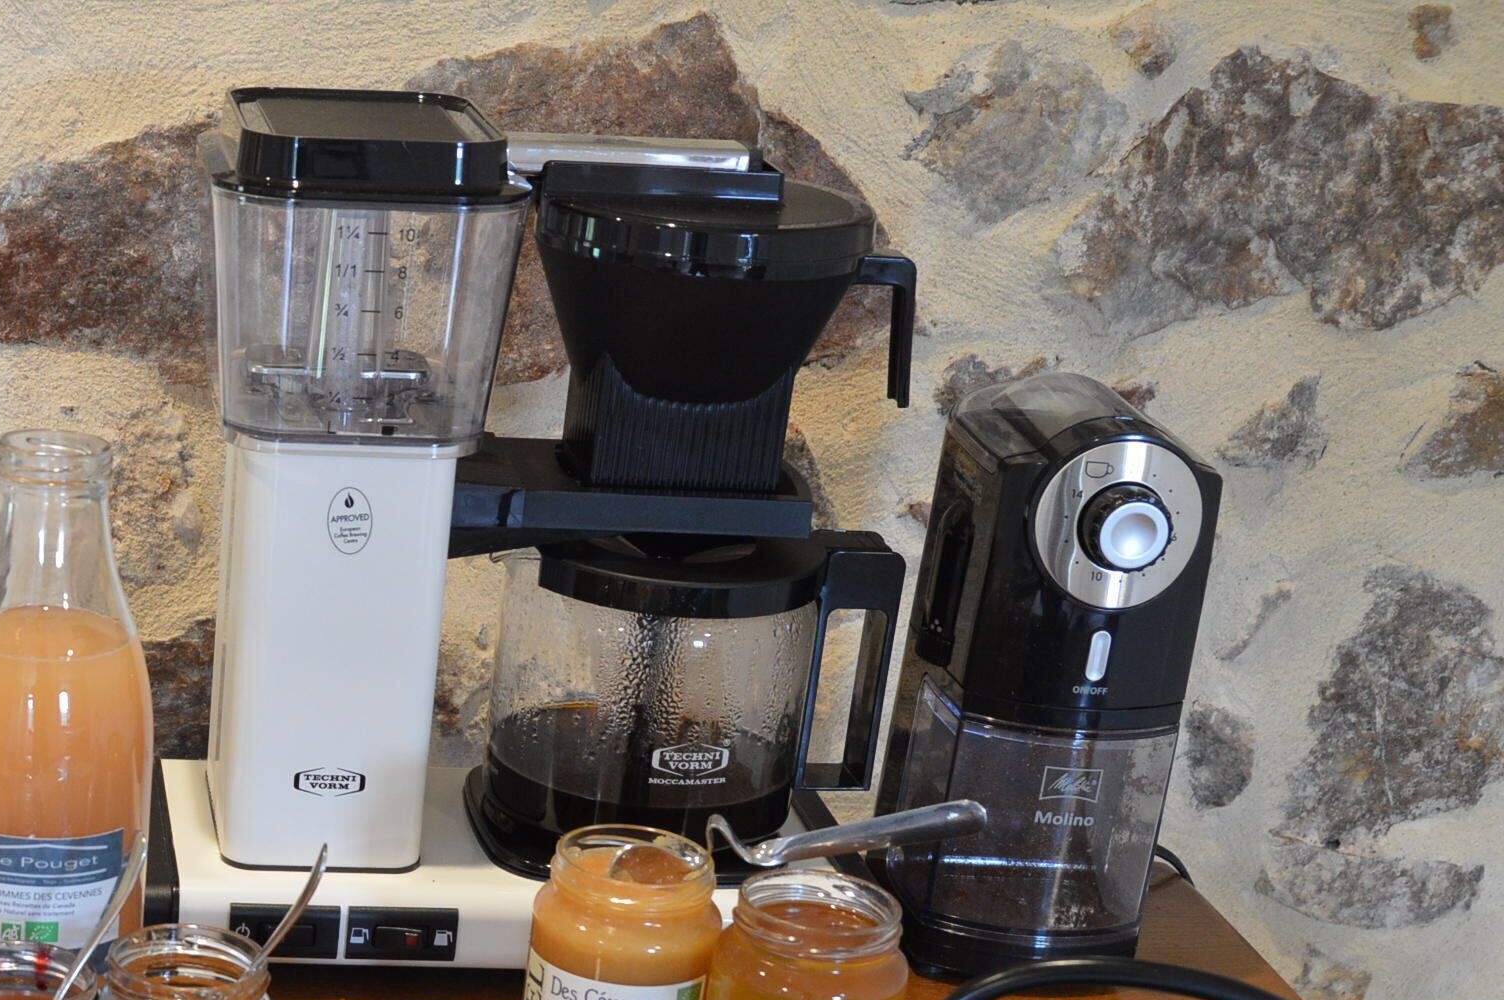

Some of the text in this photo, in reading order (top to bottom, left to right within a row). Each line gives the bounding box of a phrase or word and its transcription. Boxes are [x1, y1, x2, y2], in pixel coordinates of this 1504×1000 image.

[399, 228, 415, 242] 10
[336, 263, 407, 280] 1/1 8
[394, 306, 404, 320] 6
[331, 513, 369, 523] APPROVED
[1090, 571, 1103, 582] 10
[1072, 685, 1109, 696] ON/OFF
[662, 751, 721, 761] TECHNI
[668, 761, 713, 770] VORM
[303, 774, 357, 782] TECHNI
[648, 777, 727, 785] MOCCAMASTER
[1034, 810, 1095, 827] Molino
[21, 855, 99, 871] Pouget
[33, 892, 52, 901] DES
